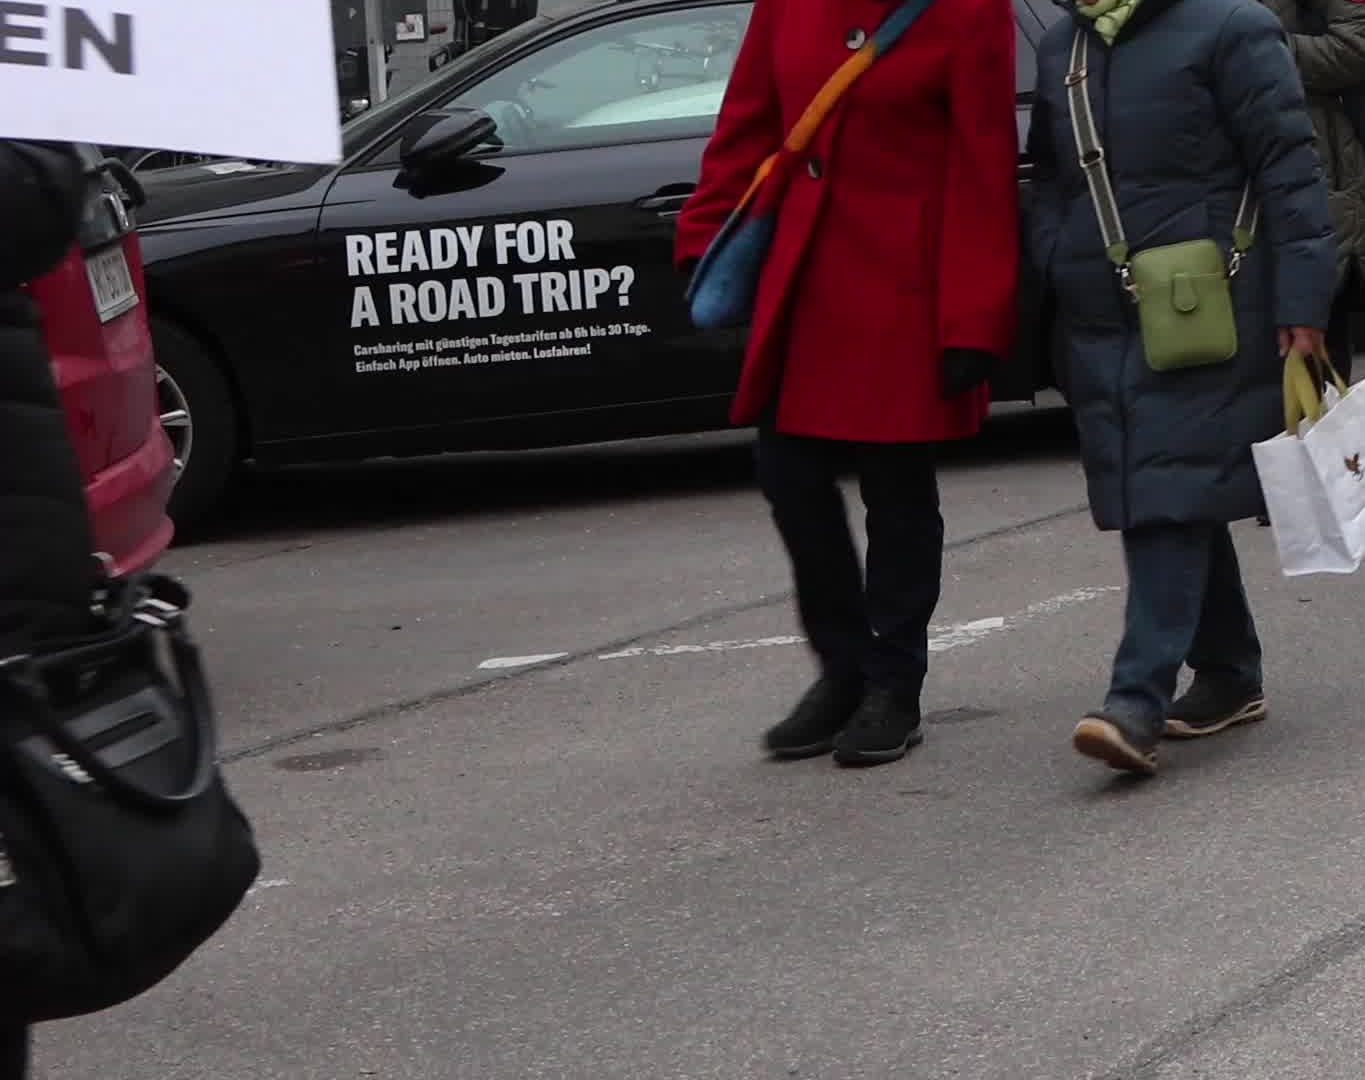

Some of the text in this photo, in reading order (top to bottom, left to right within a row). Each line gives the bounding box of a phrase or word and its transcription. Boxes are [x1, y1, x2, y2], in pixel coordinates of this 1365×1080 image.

[0, 0, 136, 76] EN
[345, 219, 576, 277] READY FOR
[350, 265, 635, 328] A ROAD TRIP?
[354, 341, 414, 357] Carsharing
[415, 339, 434, 353] mit
[436, 335, 489, 353] günstigen
[490, 329, 558, 347] Tagestarifen
[558, 327, 573, 340] ab
[589, 325, 607, 338] bis
[607, 323, 623, 336] 30
[622, 322, 652, 337] Tage.
[355, 342, 593, 373] Einfach App öffnen. Auto mieten. Losfahren!
